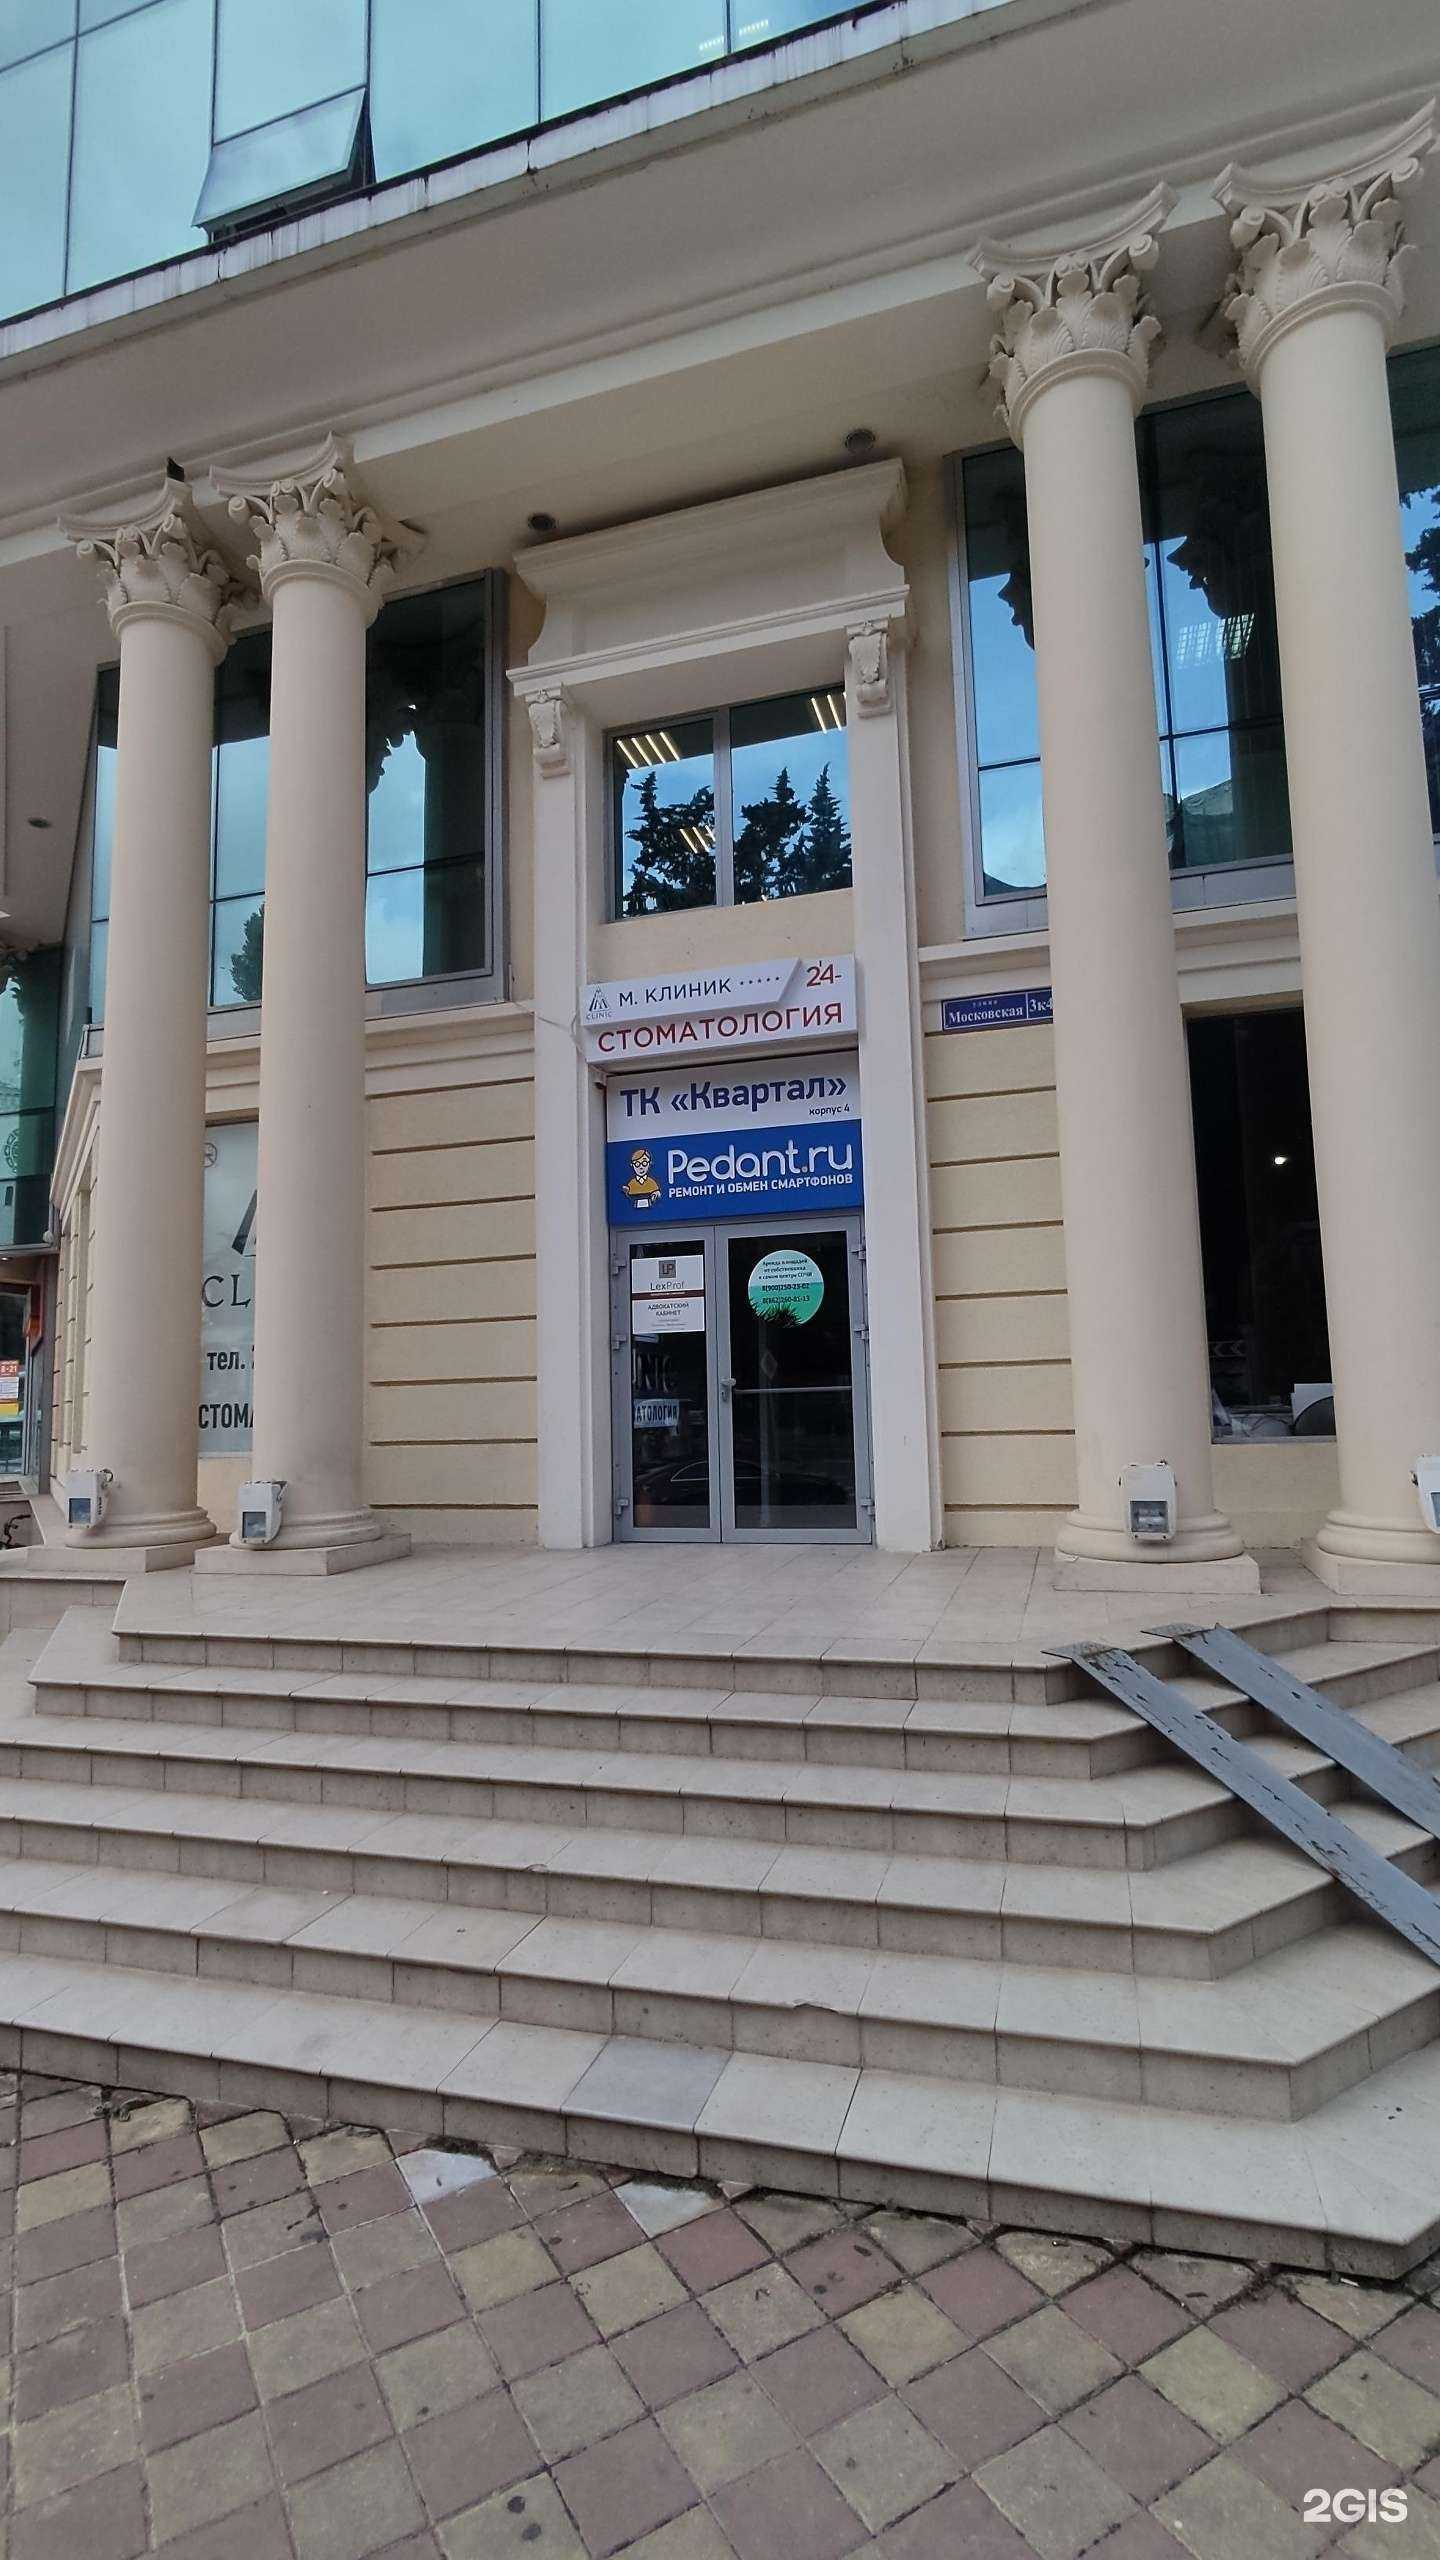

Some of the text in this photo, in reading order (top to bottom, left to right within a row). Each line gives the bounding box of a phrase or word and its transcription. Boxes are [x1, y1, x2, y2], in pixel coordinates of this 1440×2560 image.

[619, 978, 732, 1007] М. КЛИНИК
[586, 1011, 613, 1020] CLINIC
[597, 1002, 843, 1053] СТОМАТОЛОГИЯ
[948, 1006, 1024, 1025] Московская
[620, 1076, 847, 1117] ТК «Квартал»
[809, 1104, 850, 1117] корпус 4
[667, 1139, 853, 1185] Pedant.ru
[668, 1173, 853, 1198] РЕМОНТ И ОБМЕН СМАРТФОНОВ
[206, 1351, 246, 1371] тел.
[197, 1402, 254, 1430] СТОМ
